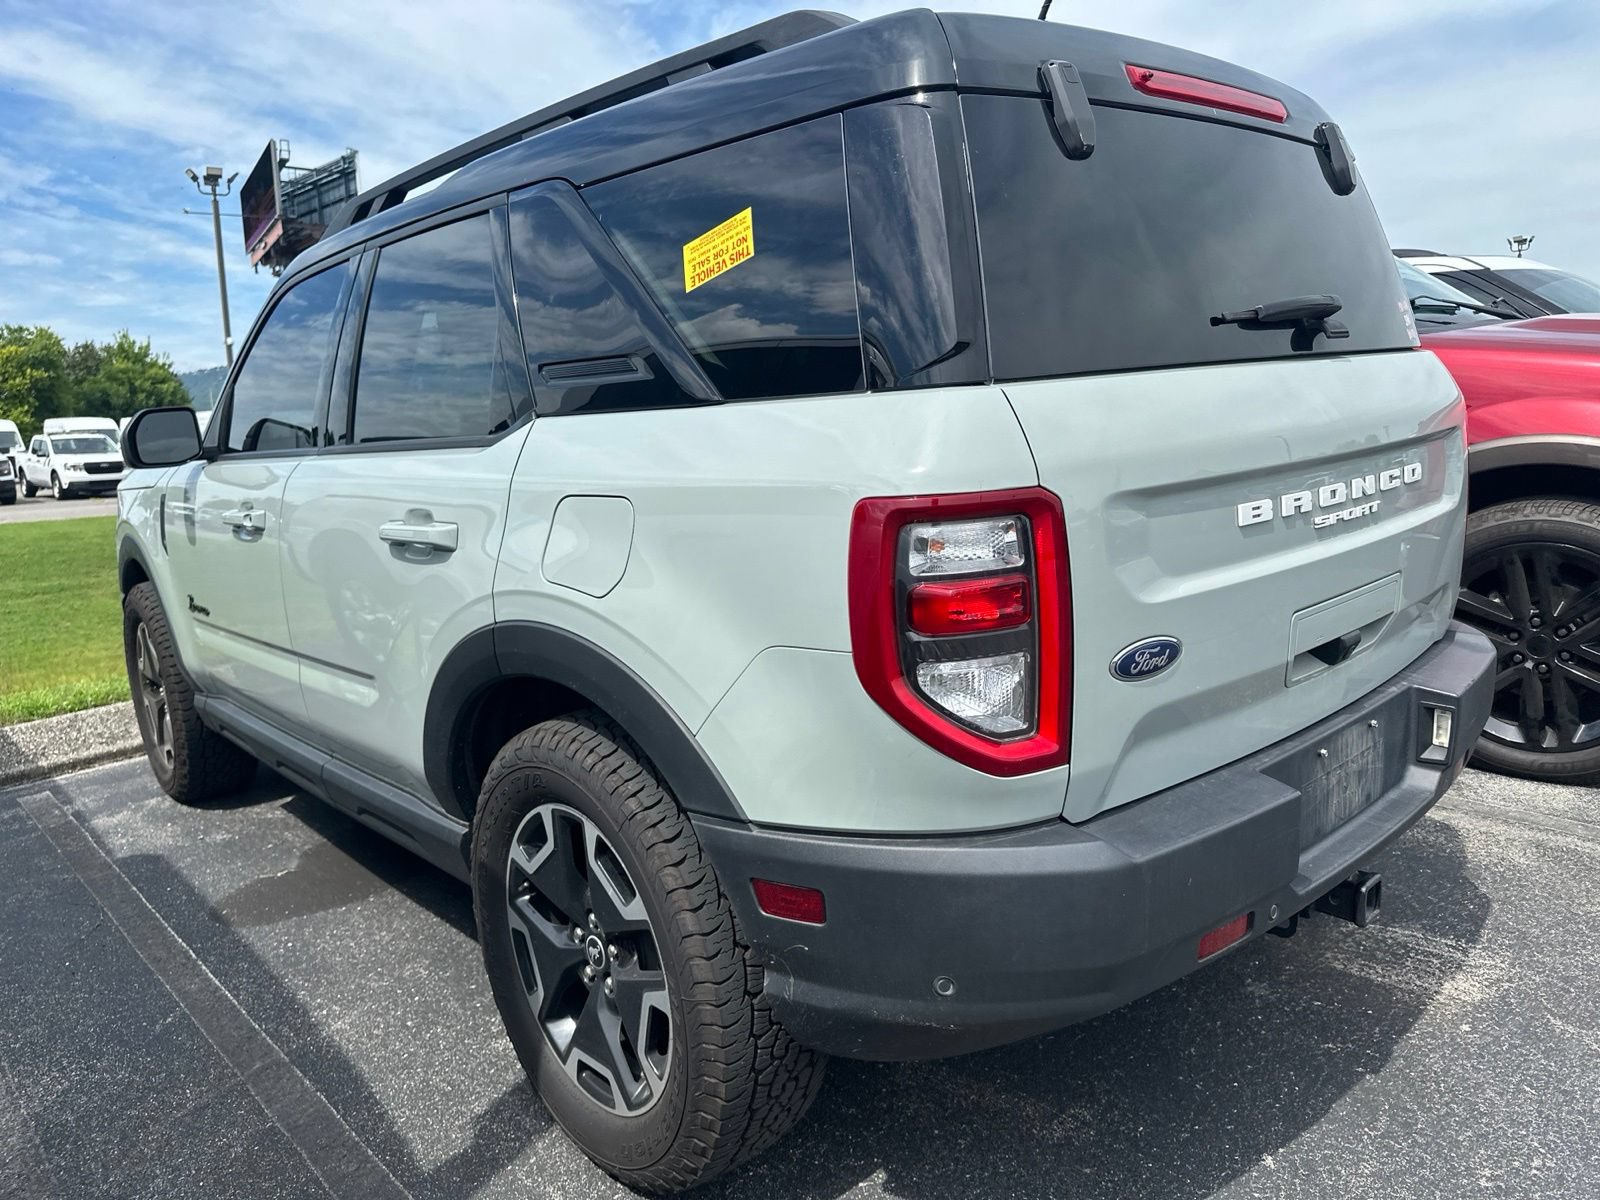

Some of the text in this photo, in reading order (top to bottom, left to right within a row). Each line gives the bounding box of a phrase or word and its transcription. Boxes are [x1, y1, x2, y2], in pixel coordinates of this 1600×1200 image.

[713, 246, 729, 260] FOR
[731, 234, 748, 250] NOT
[691, 256, 711, 273] SALE
[729, 244, 751, 266] THIS
[690, 258, 727, 288] VEHICLE
[1237, 462, 1422, 527] BRONCO
[1313, 500, 1381, 529] SPORT
[1130, 646, 1170, 674] Ford
